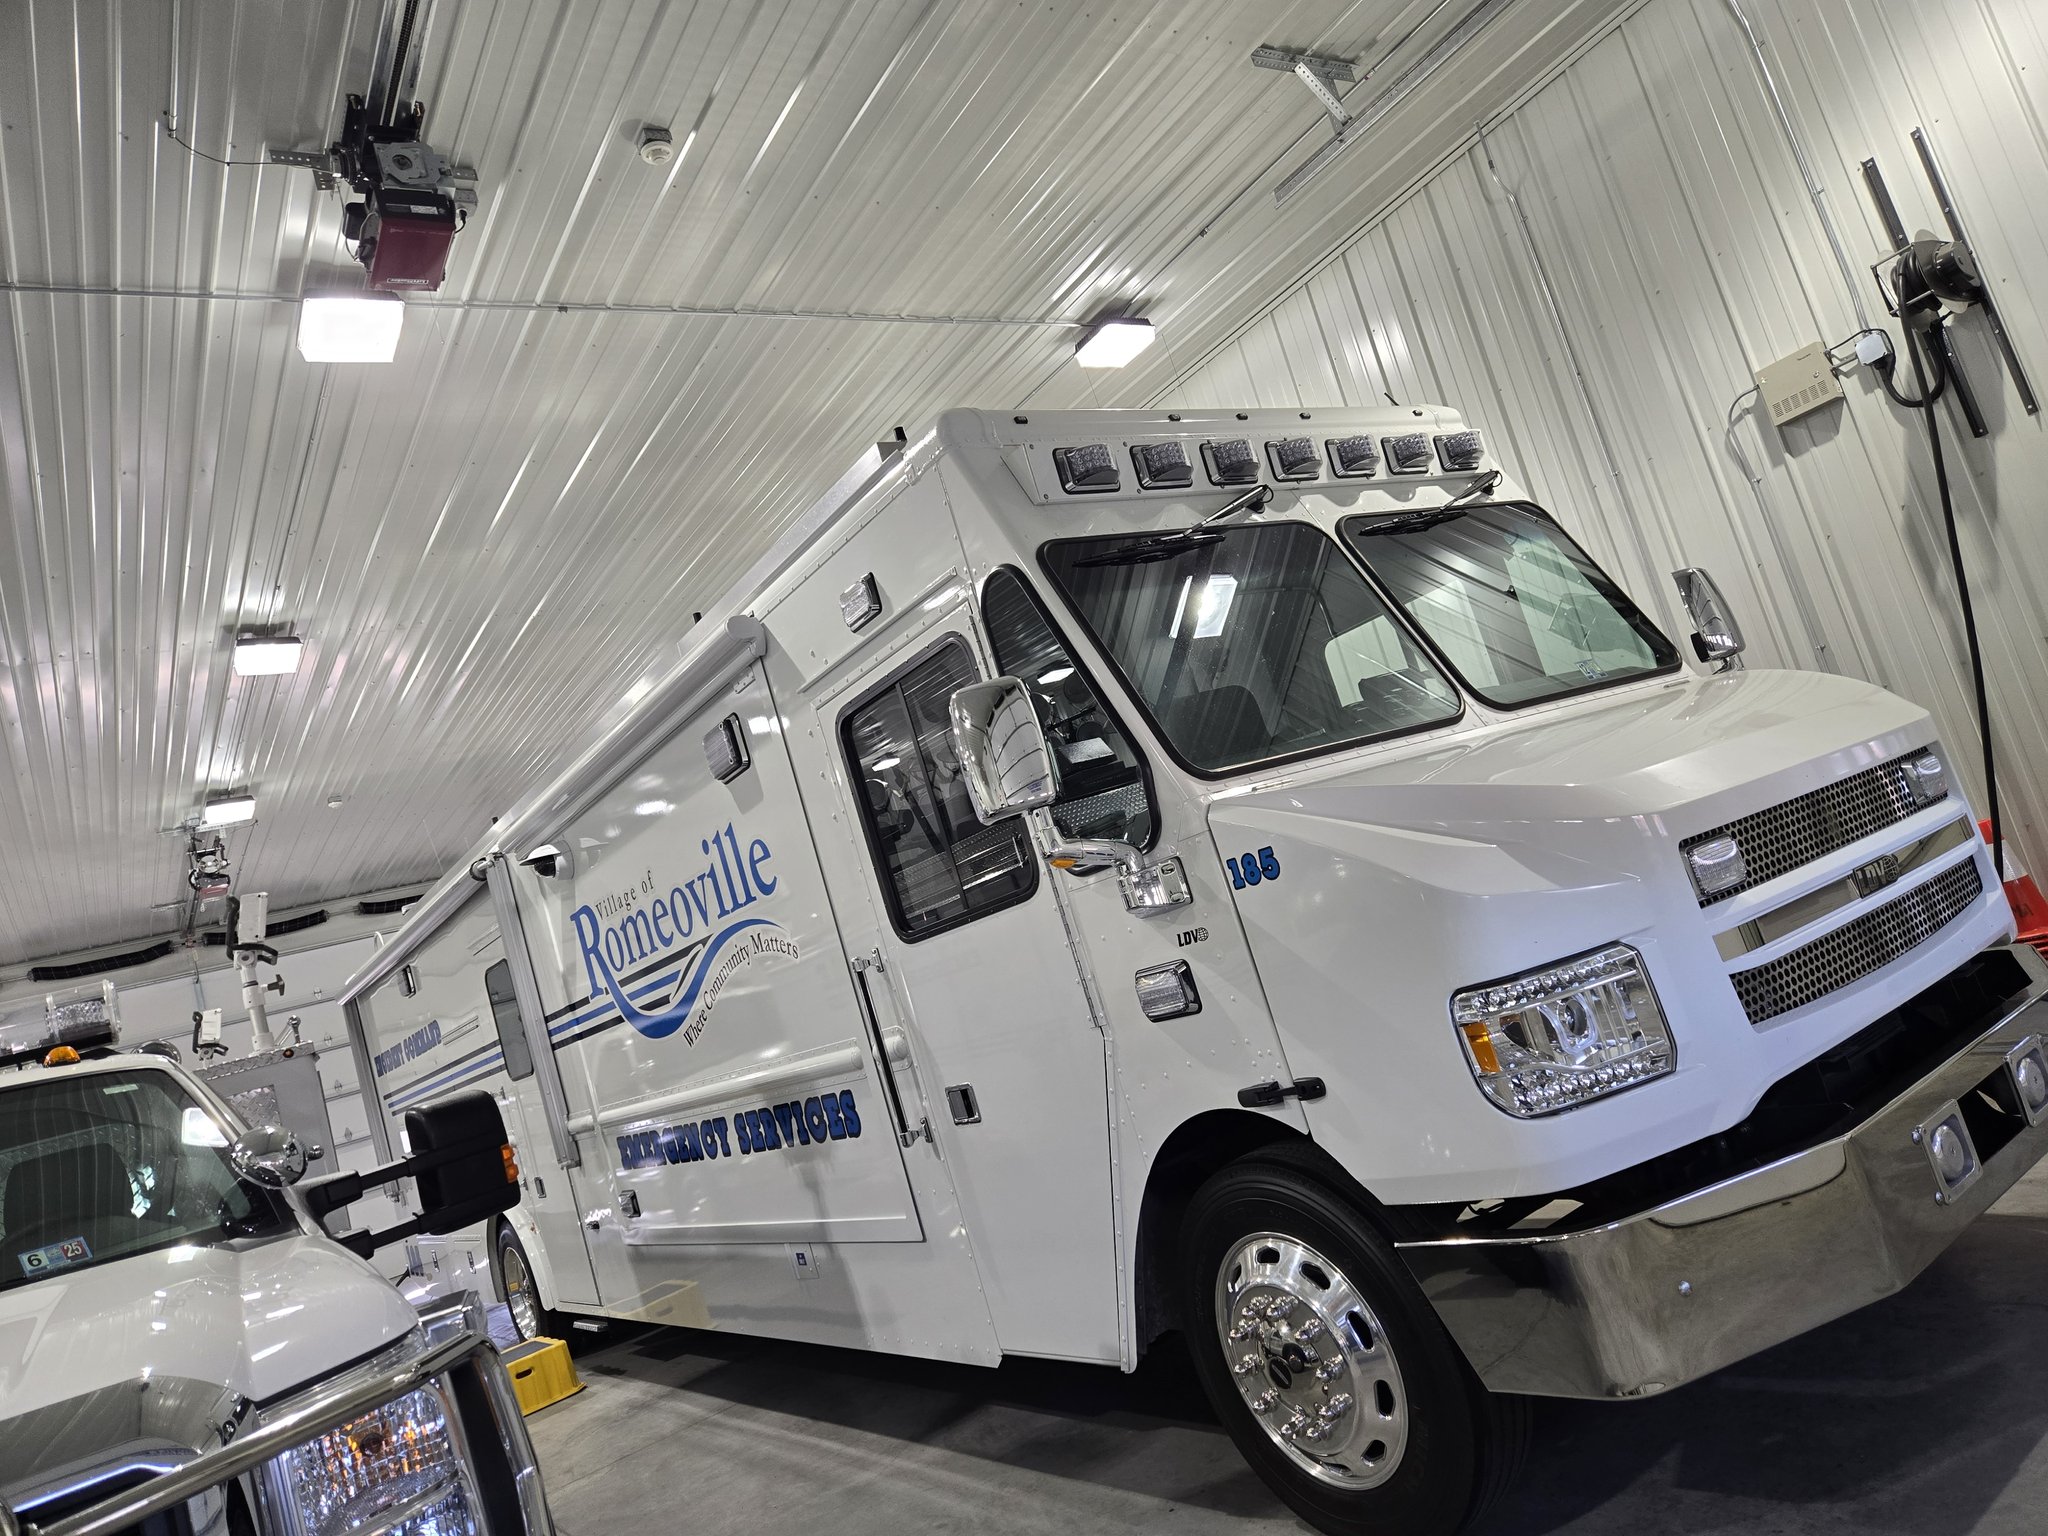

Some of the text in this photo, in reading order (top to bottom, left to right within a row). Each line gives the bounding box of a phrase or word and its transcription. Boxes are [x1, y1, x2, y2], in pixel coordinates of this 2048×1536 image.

[1226, 846, 1280, 890] 185
[570, 821, 778, 1001] Romeoville
[595, 870, 655, 920] Village of
[1177, 928, 1199, 947] LDV
[683, 933, 799, 1049] Where Community Matters
[617, 1089, 862, 1170] EMERGENCY SERVICES
[27, 1254, 42, 1267] 6
[64, 1241, 82, 1257] 25
